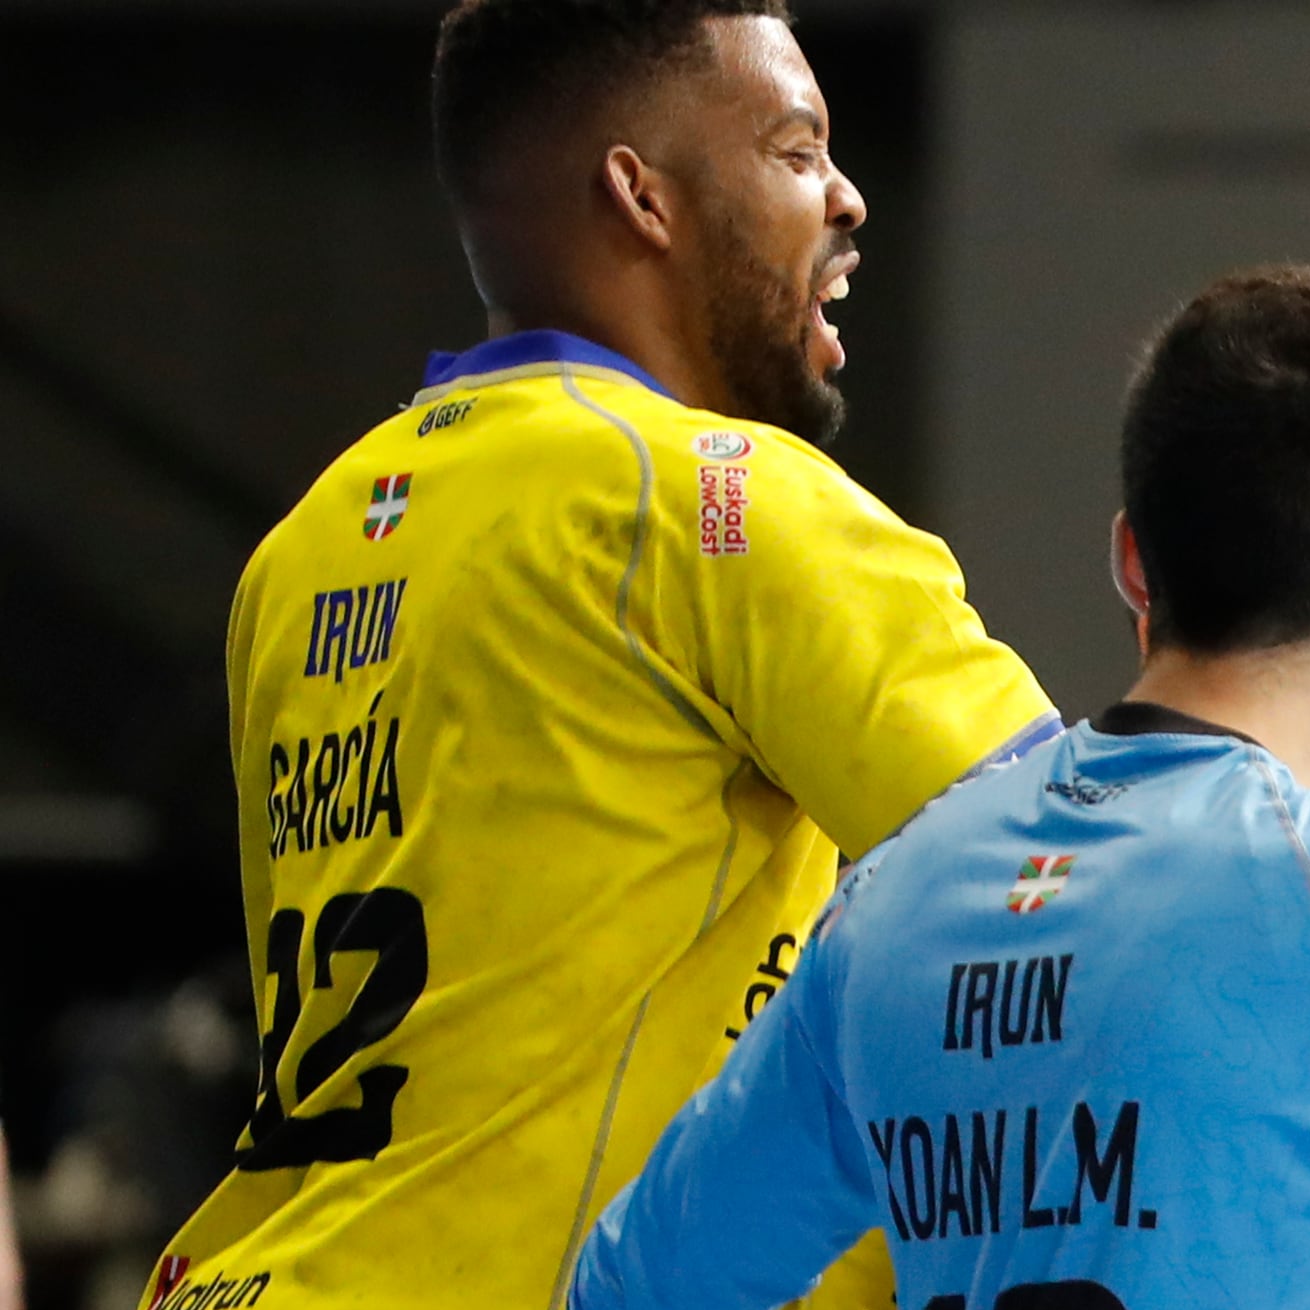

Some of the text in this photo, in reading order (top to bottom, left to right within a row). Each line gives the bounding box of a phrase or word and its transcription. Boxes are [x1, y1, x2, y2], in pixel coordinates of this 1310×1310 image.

[700, 466, 722, 556] LowCost
[724, 467, 748, 554] Euskadi
[303, 578, 408, 683] IRUN
[267, 692, 404, 861] GARCÍA
[942, 953, 1074, 1058] IRUN
[1022, 1100, 1157, 1229] L.M.
